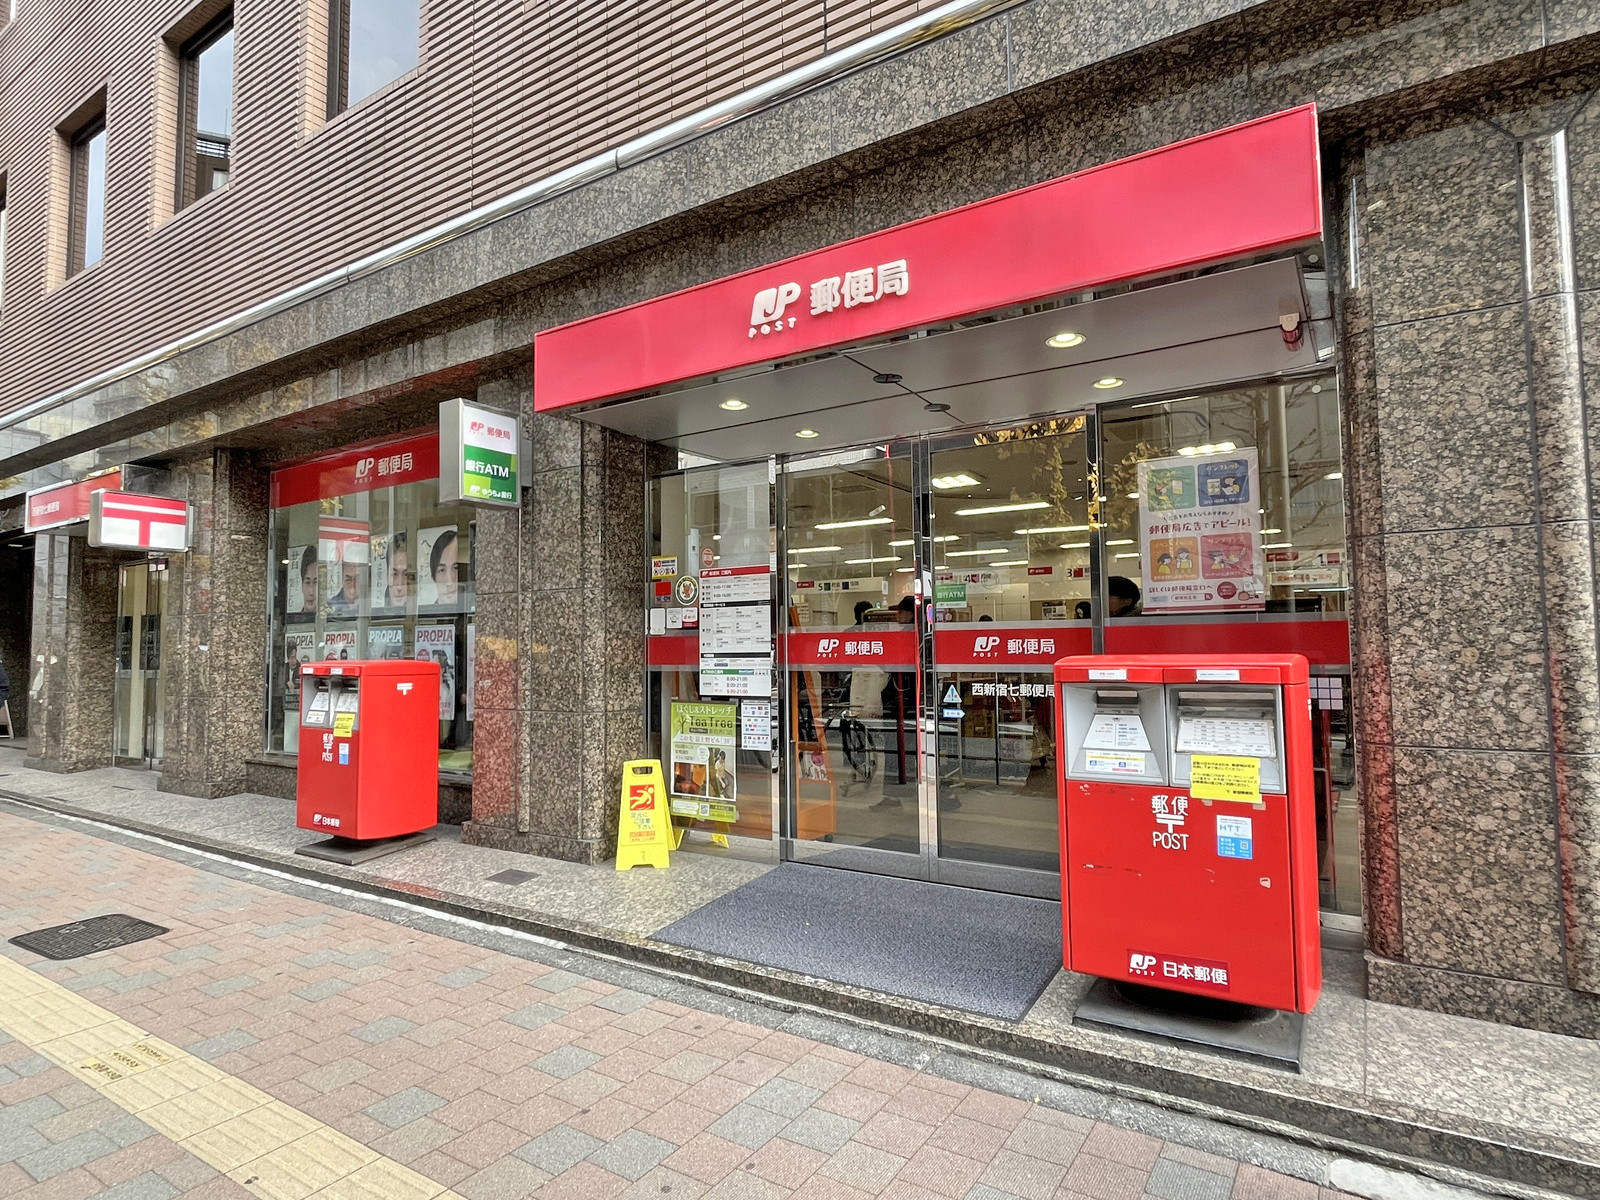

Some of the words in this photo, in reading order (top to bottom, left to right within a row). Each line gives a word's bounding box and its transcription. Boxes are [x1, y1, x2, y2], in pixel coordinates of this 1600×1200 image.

[810, 259, 909, 315] 郵便局
[748, 317, 797, 339] POST
[487, 426, 511, 440] 郵便局
[378, 452, 413, 476] 郵便局
[465, 459, 509, 478] 銀行ATM
[1318, 554, 1324, 563] 1
[1067, 568, 1072, 577] 3
[818, 583, 823, 591] 5
[325, 633, 355, 645] PROPIA
[368, 629, 402, 643] PROPIA
[416, 629, 453, 642] PROPIA
[844, 641, 884, 656] 郵便局
[1007, 638, 1055, 655] 郵便局
[971, 683, 1056, 698] 西新宿七郵便局
[676, 705, 733, 716] ほぐし&ストレッチ
[1151, 795, 1189, 816] 郵便
[1219, 824, 1240, 832] HTT
[1152, 831, 1189, 850] POST
[1129, 968, 1155, 976] POST
[1163, 960, 1228, 986] 日本郵便
